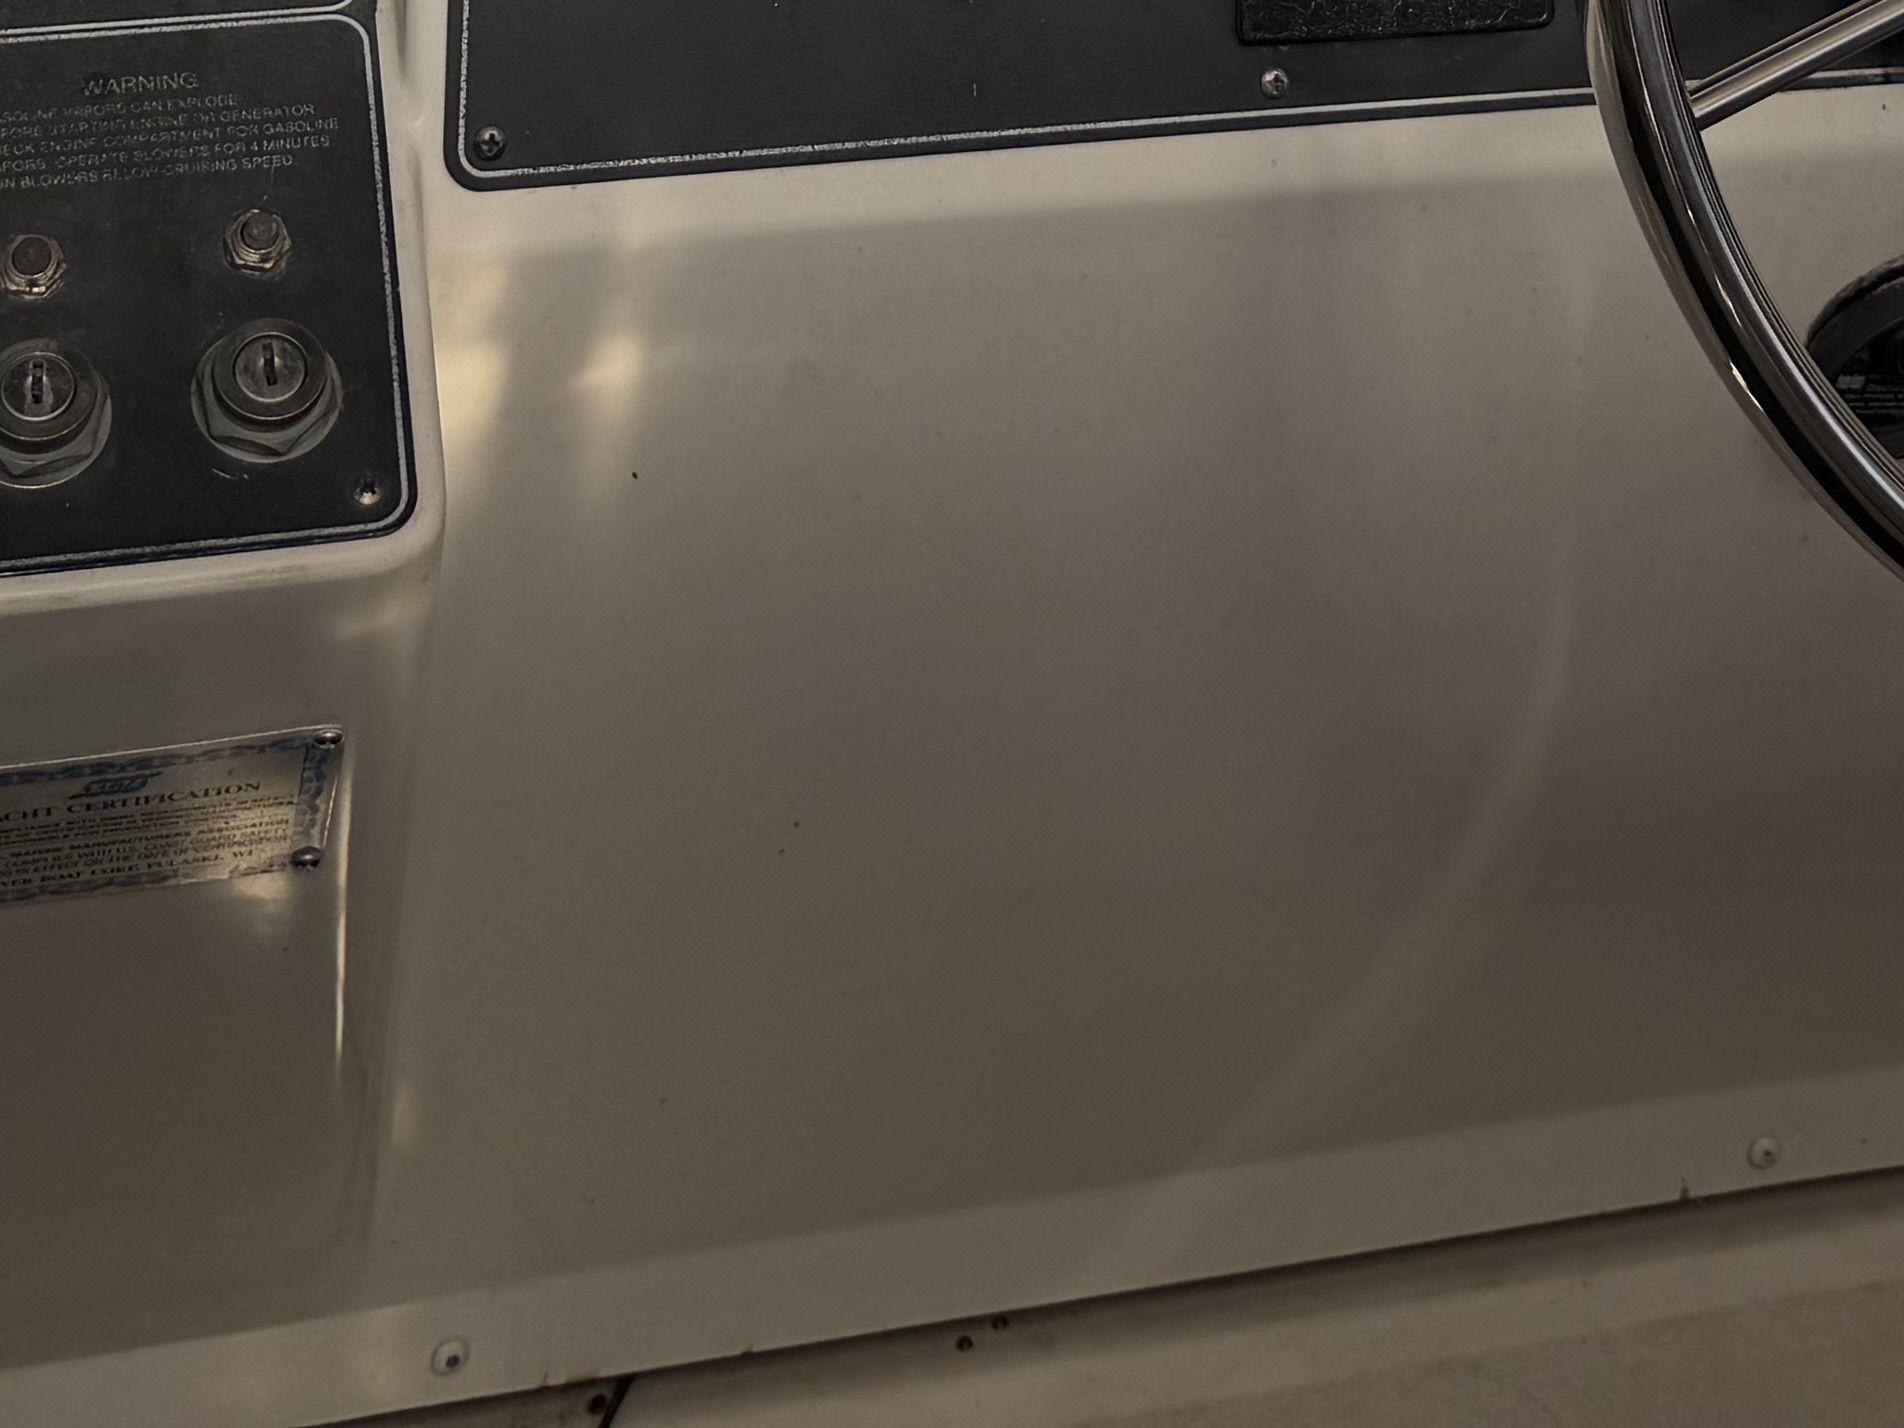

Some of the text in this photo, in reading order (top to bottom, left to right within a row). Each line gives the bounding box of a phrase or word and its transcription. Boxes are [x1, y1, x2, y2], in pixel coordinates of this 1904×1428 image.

[81, 71, 199, 97] WARNING
[219, 103, 315, 123] GENERATOR
[262, 117, 339, 135] GASOLINE
[65, 781, 262, 814] CERTIFICATION
